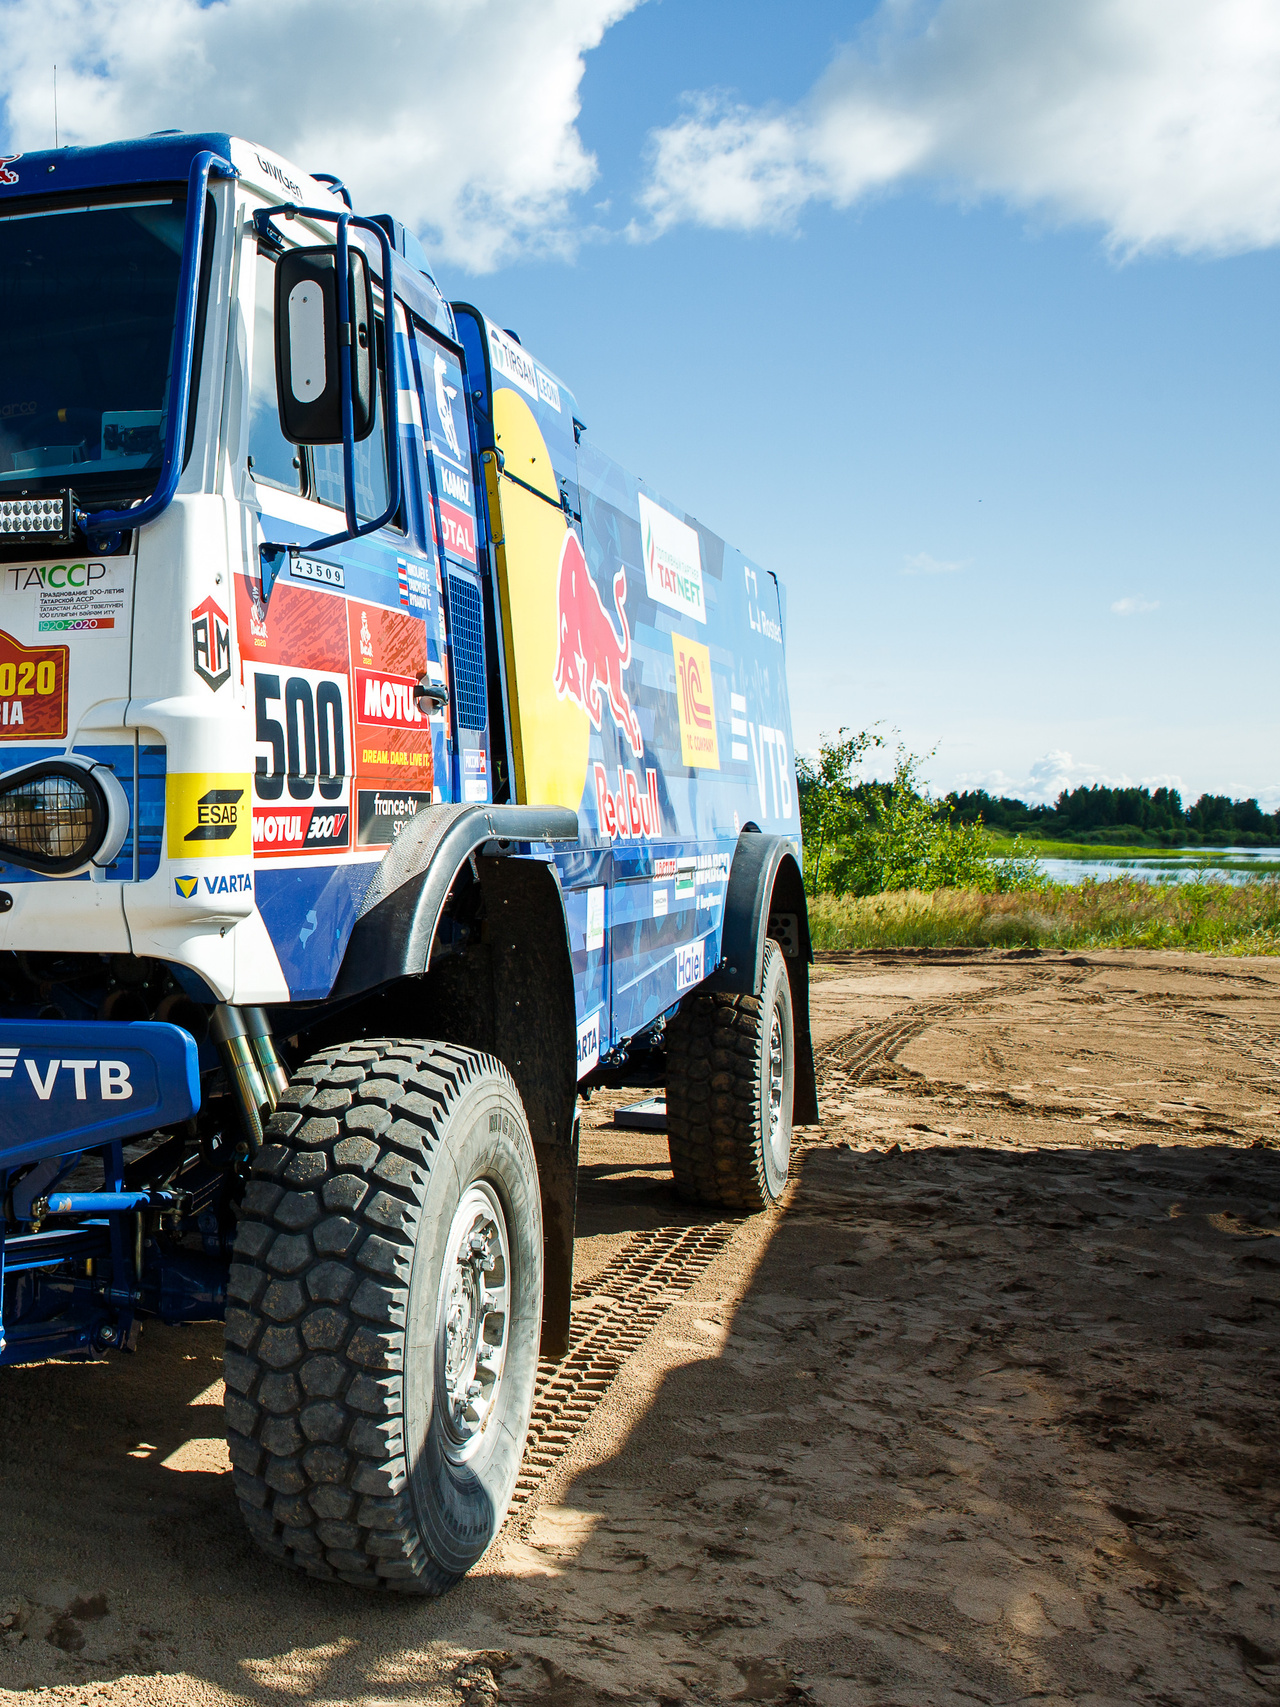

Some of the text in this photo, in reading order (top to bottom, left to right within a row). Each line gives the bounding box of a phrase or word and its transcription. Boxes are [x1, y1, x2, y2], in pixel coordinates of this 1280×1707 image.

[441, 466, 471, 507] KAMAZ
[295, 563, 342, 583] 43509
[657, 563, 700, 607] TATNEFT
[40, 620, 98, 630] 1920-2020
[254, 638, 266, 647] 2020
[253, 673, 346, 801] 500
[362, 750, 389, 764] DREAM.
[390, 752, 409, 766] DARE.
[410, 753, 422, 766] LIVE
[748, 721, 793, 820] VTB
[198, 805, 238, 824] ESAB
[593, 762, 662, 841] Red Bull
[253, 813, 347, 842] MOTUL 300V
[204, 873, 252, 894] VARTA
[678, 946, 704, 986] Haier
[577, 1028, 597, 1062] ARTA
[24, 1059, 133, 1100] VTB
